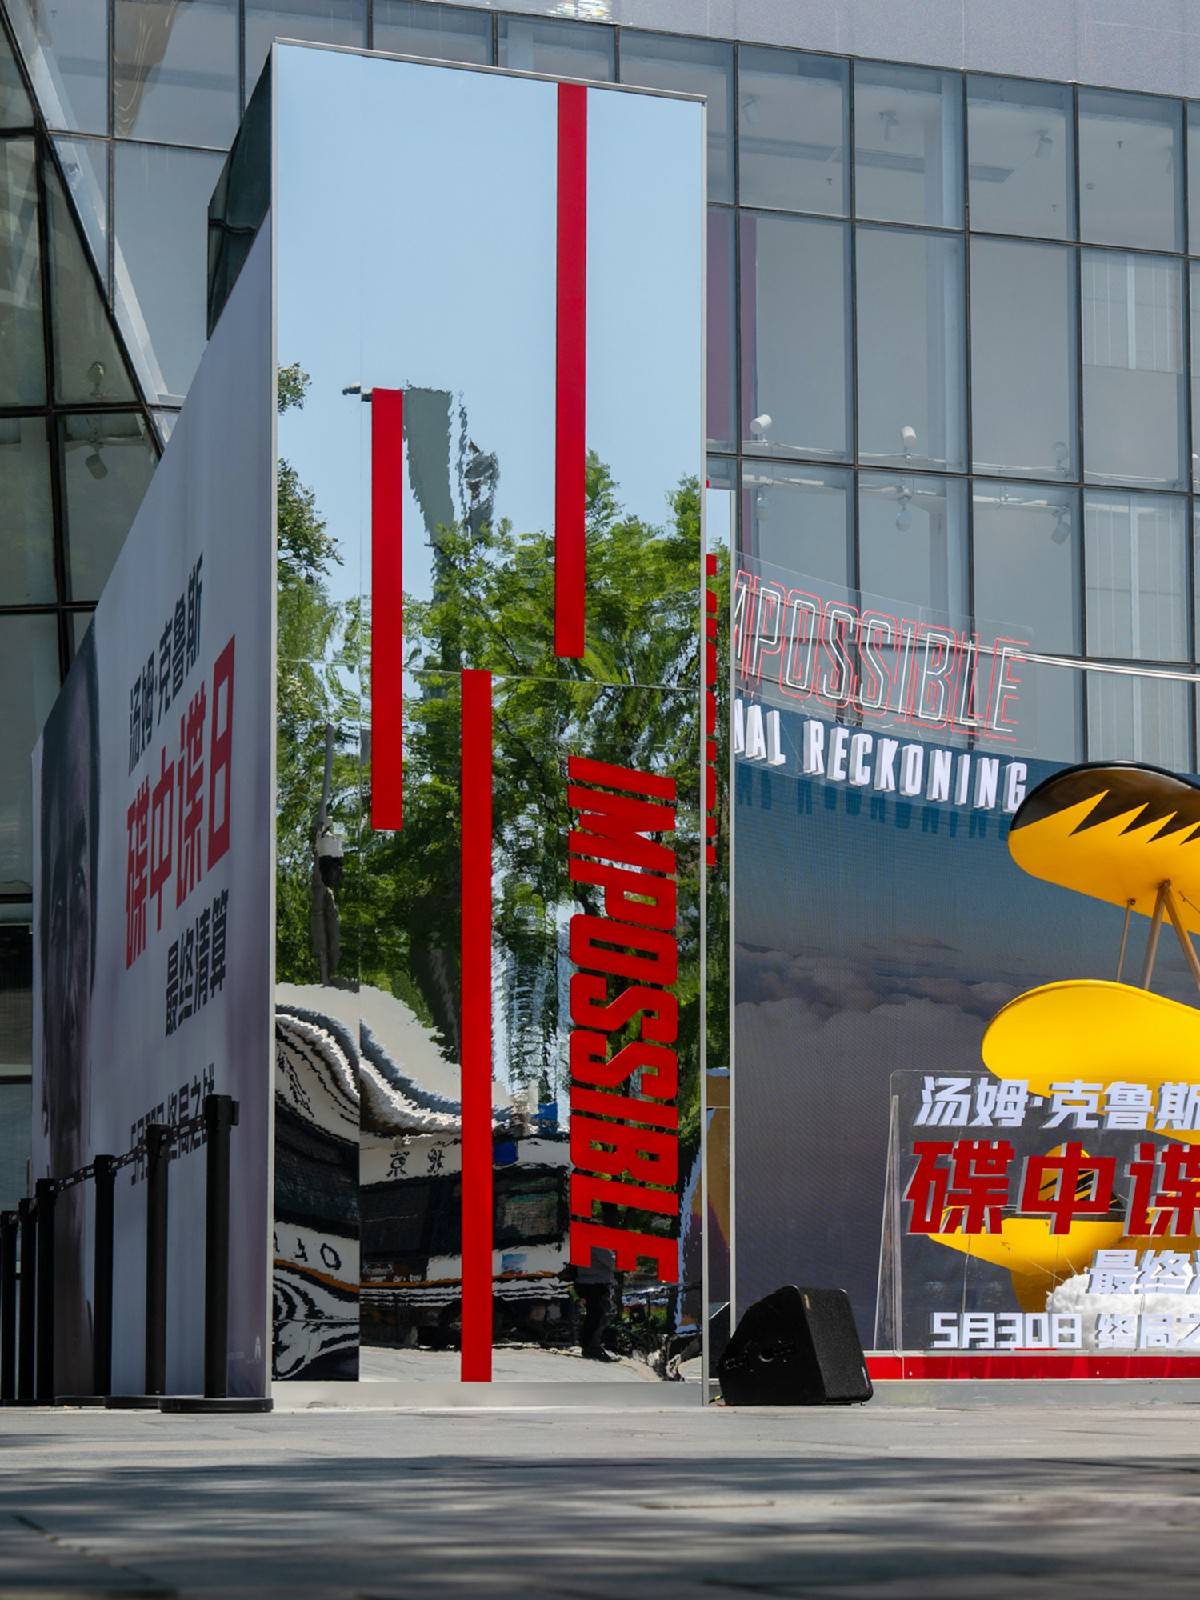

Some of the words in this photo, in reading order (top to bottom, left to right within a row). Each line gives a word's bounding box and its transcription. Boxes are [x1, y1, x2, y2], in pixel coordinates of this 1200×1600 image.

[129, 553, 203, 777] 汤姆·克鲁斯
[803, 720, 1028, 815] RECKONING
[165, 888, 229, 1035] 最终清算
[568, 756, 678, 1284] IMPOSSIBLE
[930, 1312, 1083, 1349] 5月30日
